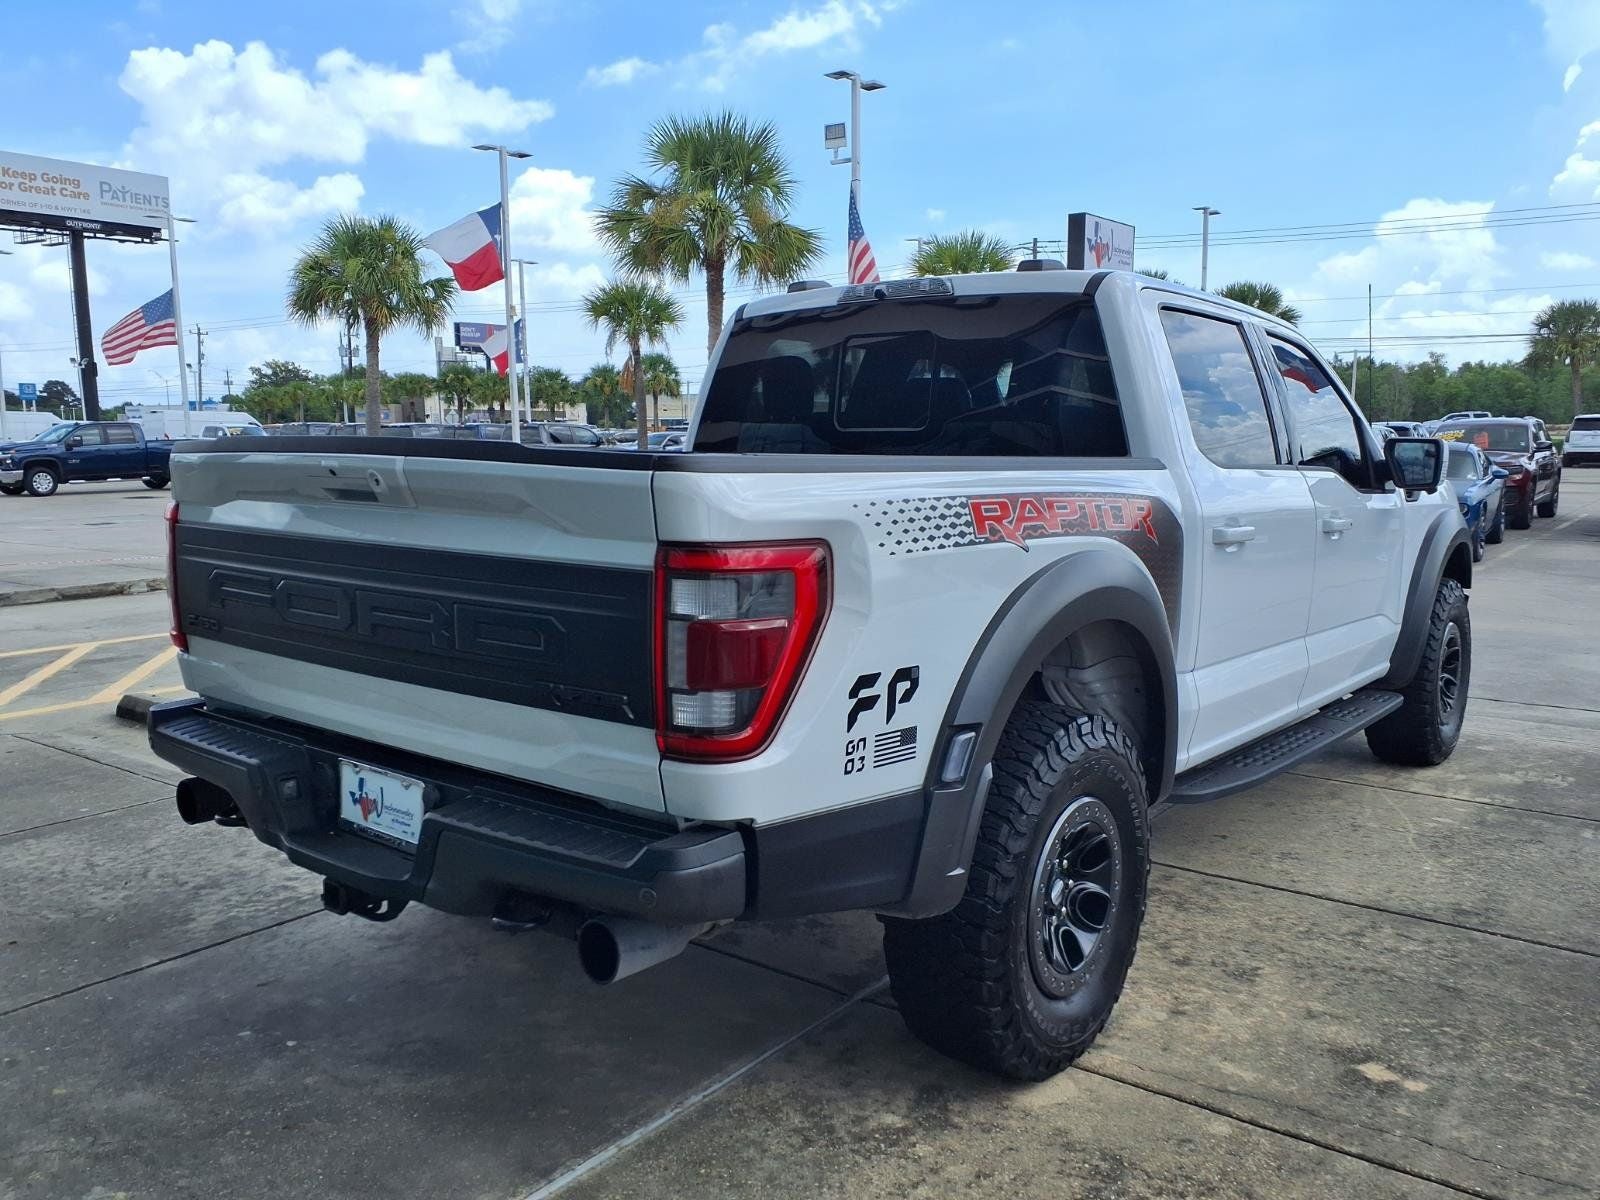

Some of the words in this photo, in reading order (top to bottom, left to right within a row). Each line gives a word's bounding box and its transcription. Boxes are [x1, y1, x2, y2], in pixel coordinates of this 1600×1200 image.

[1, 166, 37, 183] Keep
[41, 172, 81, 189] Going
[0, 181, 15, 191] or
[18, 181, 57, 196] Great
[59, 187, 90, 201] Care
[0, 198, 27, 207] ORNER
[968, 497, 1158, 552] RAPTOR
[208, 568, 567, 664] FORD
